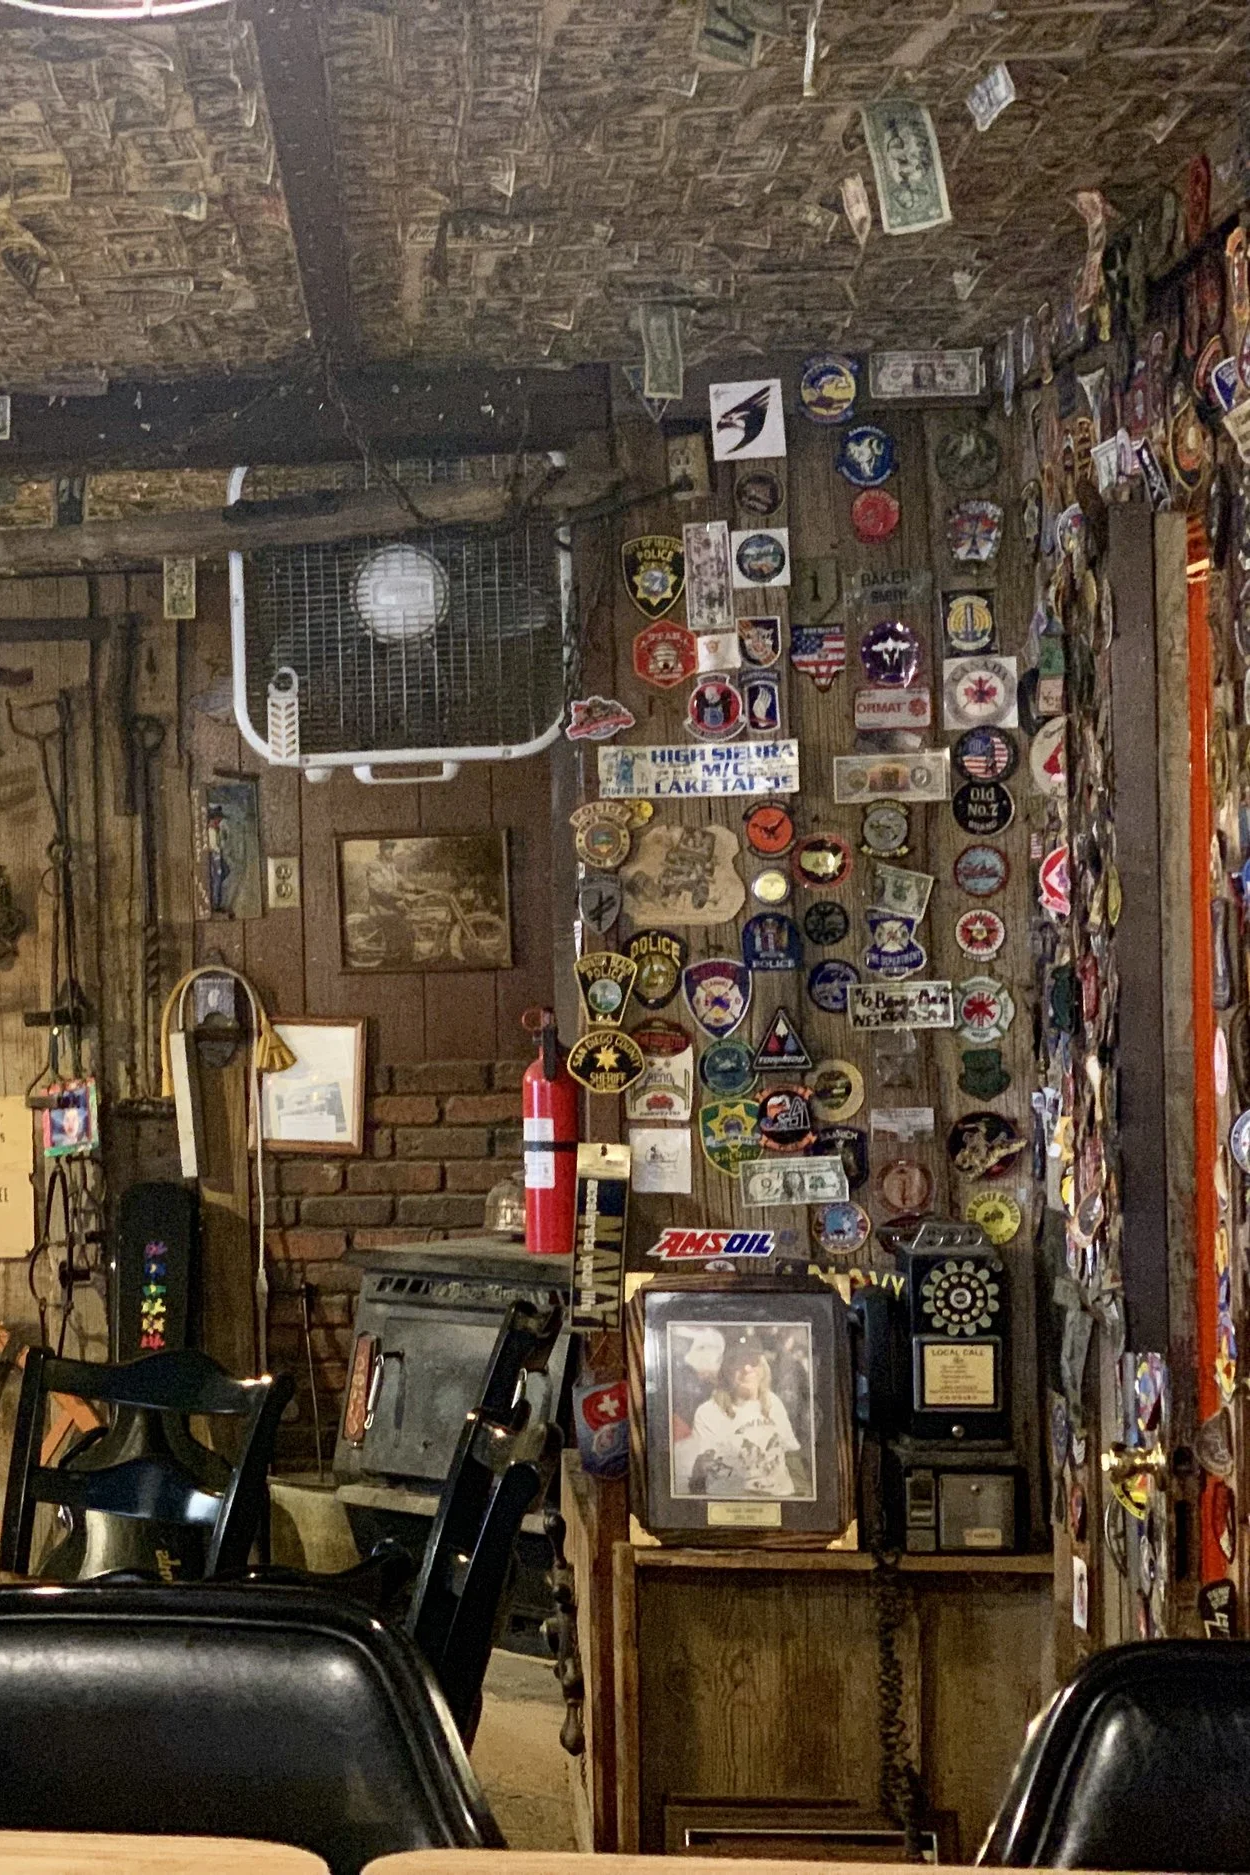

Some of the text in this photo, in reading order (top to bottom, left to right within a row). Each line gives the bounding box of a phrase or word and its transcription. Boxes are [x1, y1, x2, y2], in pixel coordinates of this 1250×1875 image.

[637, 548, 674, 562] POLICE
[860, 569, 911, 587] BAKER
[856, 702, 903, 714] ORMAT
[651, 747, 706, 766] HIGH
[702, 761, 746, 778] M/C
[655, 778, 713, 795] LAKE
[970, 786, 996, 801] Old
[572, 802, 631, 823] POLICE
[967, 819, 998, 832] BRAND
[630, 936, 681, 968] POLICE
[752, 958, 796, 969] POLICE
[586, 967, 624, 983] POLICE
[572, 1046, 588, 1068] SAN
[584, 1034, 613, 1051] DIEGO
[614, 1035, 642, 1068] COUNTY
[589, 1071, 626, 1086] SHERIFF
[580, 1179, 601, 1312] accelerate your life
[655, 1230, 772, 1257] AMSOIL
[931, 1348, 985, 1357] LOCAL CALL
